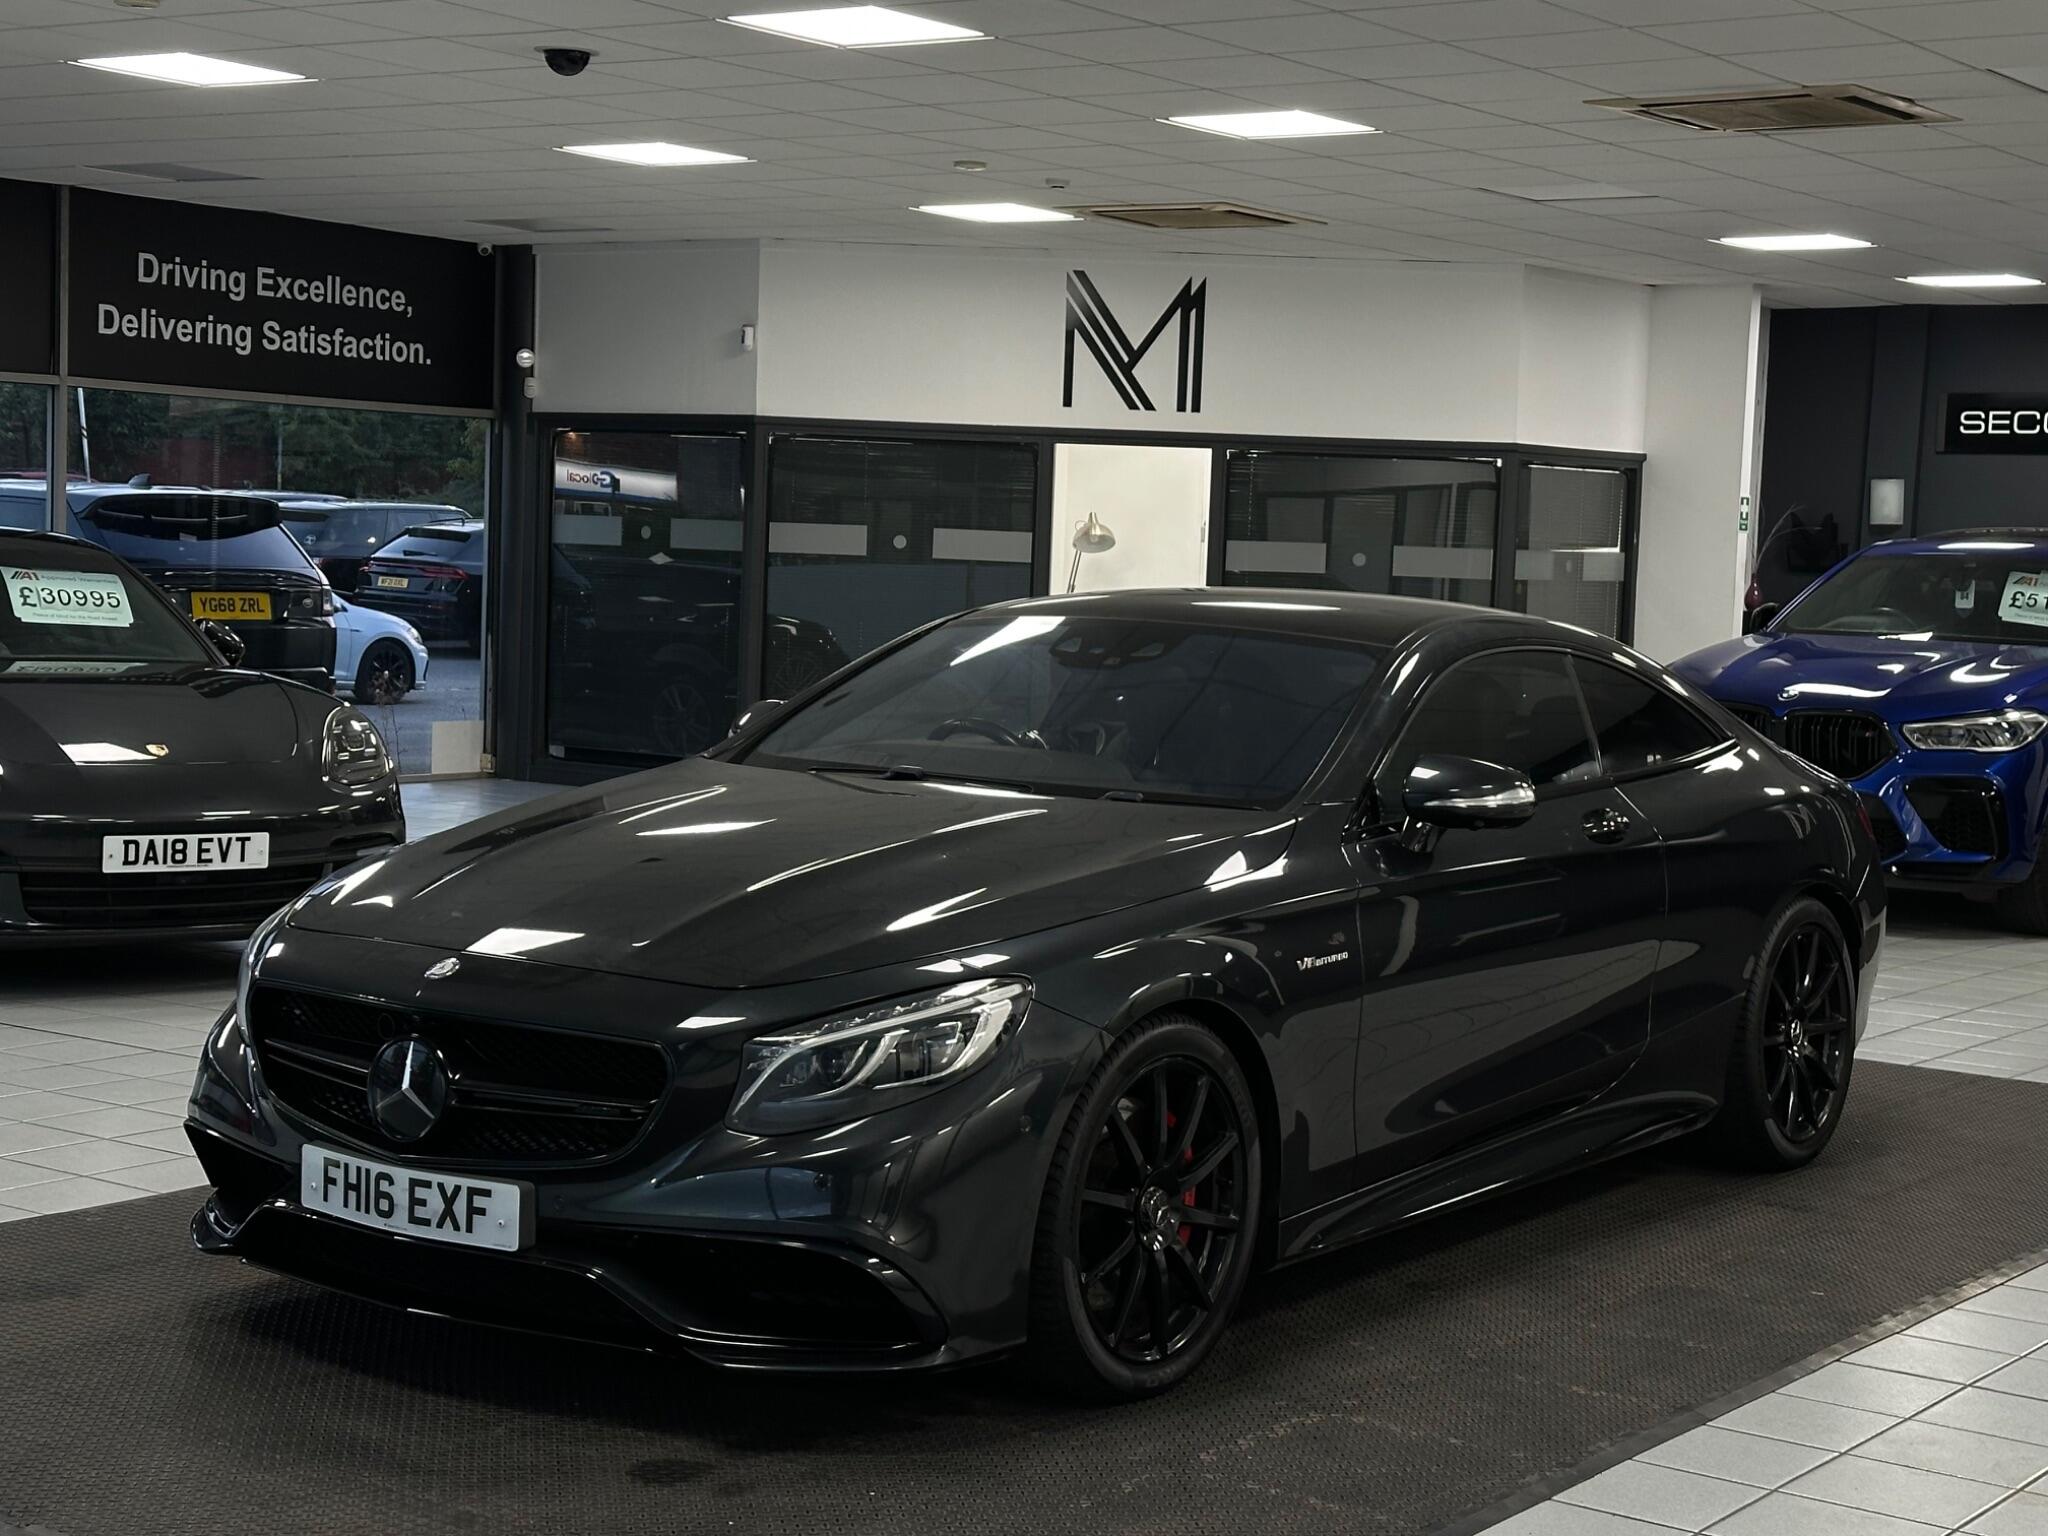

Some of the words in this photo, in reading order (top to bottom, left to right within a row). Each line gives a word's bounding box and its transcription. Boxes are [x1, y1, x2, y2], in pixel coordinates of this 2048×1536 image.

[138, 252, 246, 301] Driving
[257, 266, 413, 318] Excellence,
[98, 303, 252, 356] Delivering
[262, 320, 432, 365] Satisfaction.
[1959, 410, 2048, 434] SEC
[19, 586, 121, 609] £30995
[200, 597, 236, 613] YG68
[238, 597, 266, 613] ZRL
[122, 838, 188, 866] DA18
[196, 836, 252, 864] EVT
[322, 1156, 395, 1219] FH16
[408, 1177, 493, 1234] EXF
